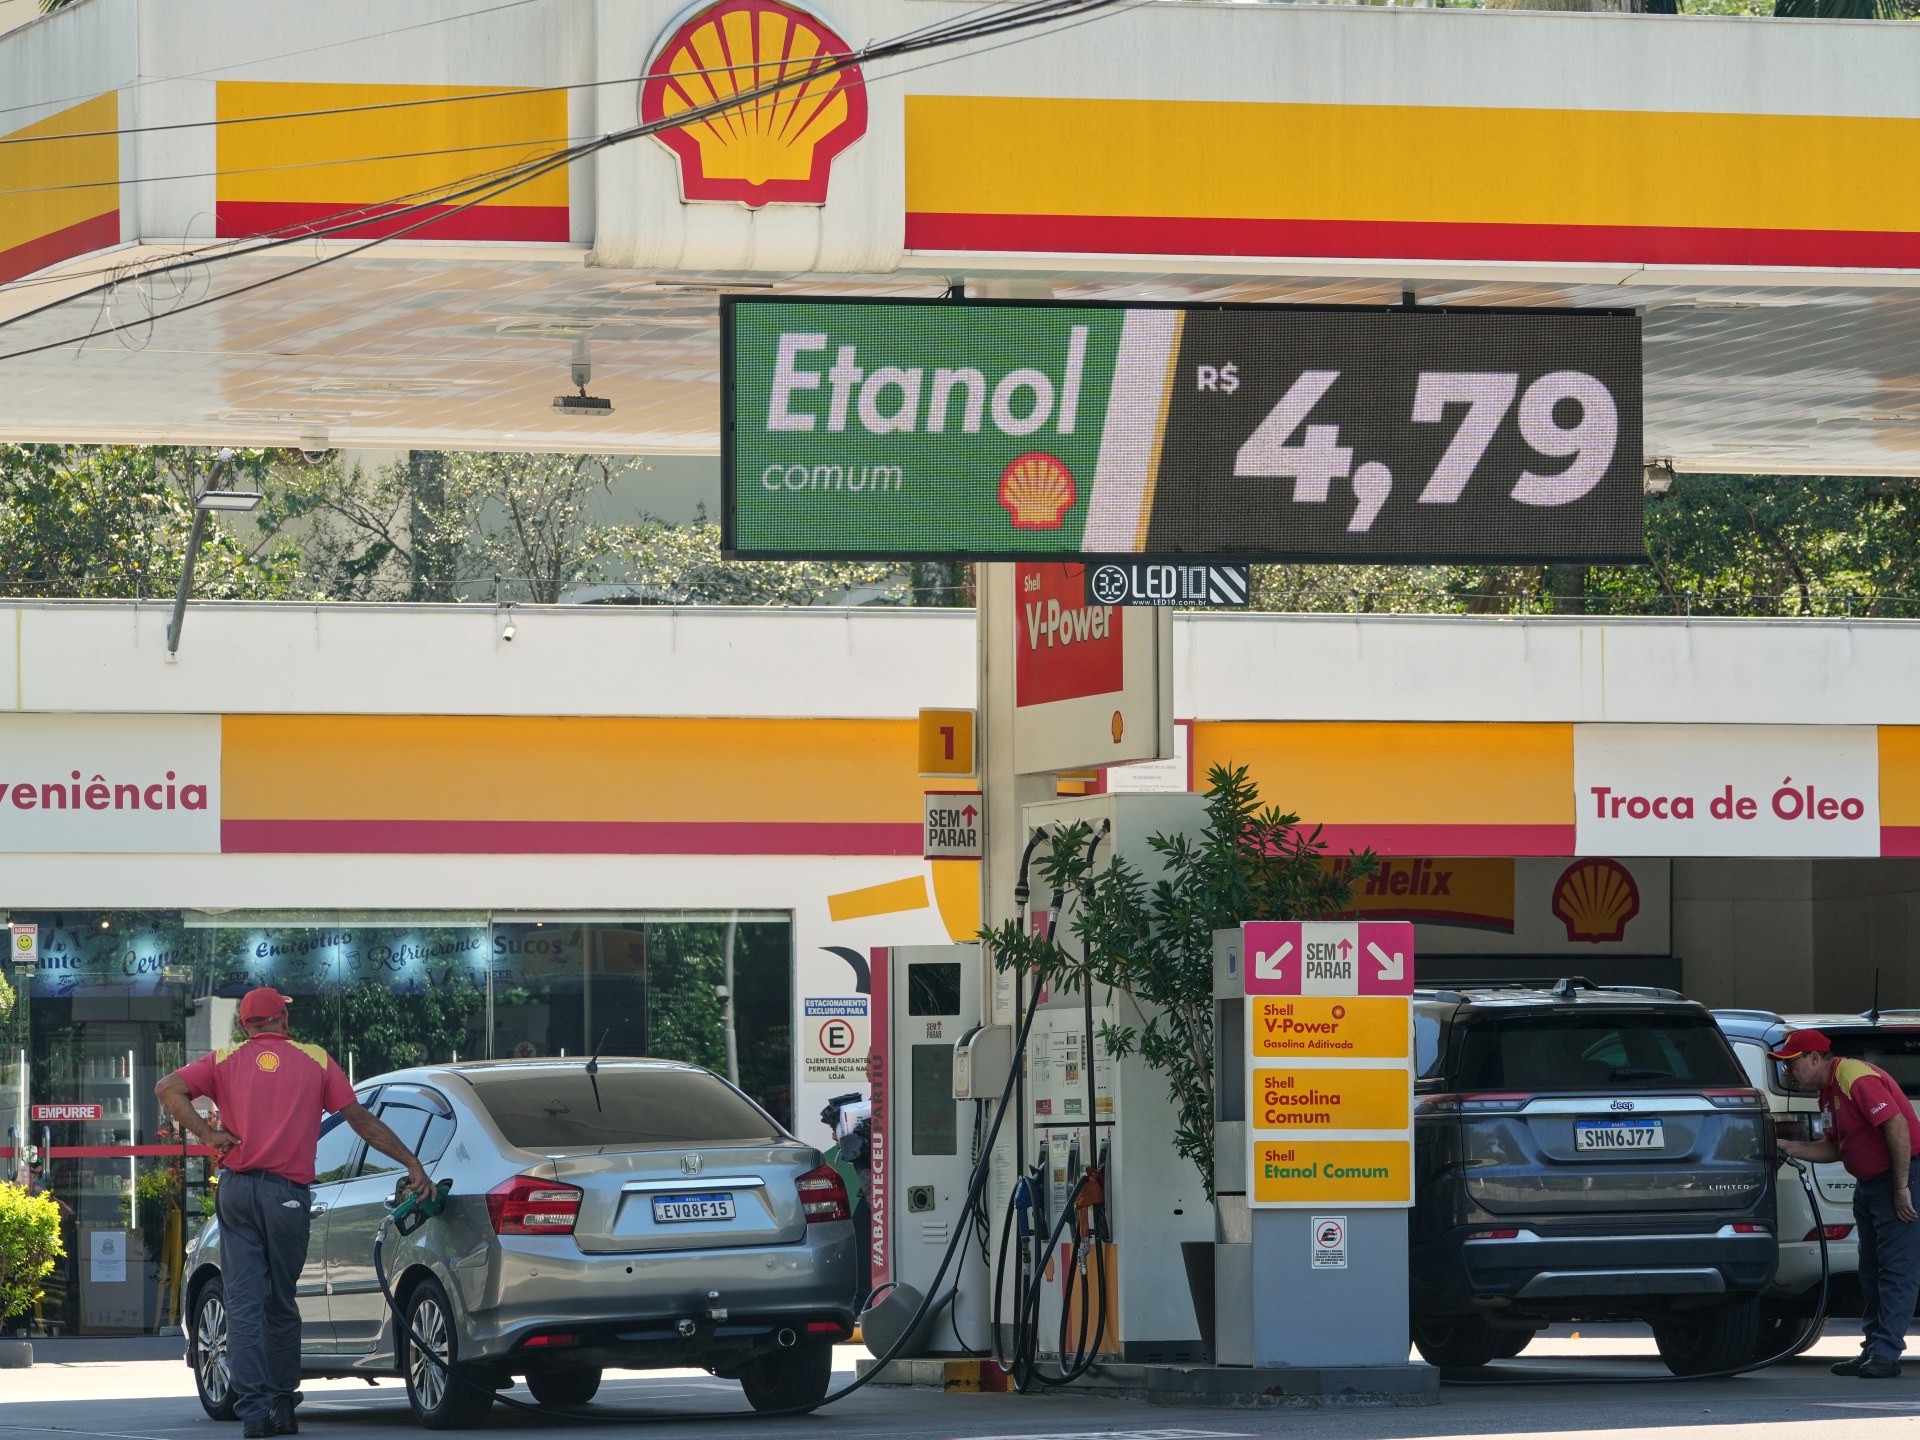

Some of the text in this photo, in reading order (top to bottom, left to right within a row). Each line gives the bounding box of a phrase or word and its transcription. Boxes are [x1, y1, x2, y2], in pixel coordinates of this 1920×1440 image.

[767, 325, 1088, 436] Etanol
[1197, 362, 1618, 532] R$ 4,79
[762, 465, 903, 491] comum
[1024, 573, 1041, 592] Shell
[1132, 566, 1207, 599] LED10
[1025, 598, 1112, 650] V-Power
[940, 727, 954, 760] 1
[1590, 776, 1864, 820] Troca de Óleo
[929, 809, 960, 828] SEM
[929, 829, 977, 847] PARAR
[1365, 859, 1453, 896] Helix
[367, 937, 481, 971] Refrigerante
[494, 935, 563, 955] Sucos
[1306, 943, 1336, 961] SEM
[1306, 961, 1352, 979] PARAR
[808, 1007, 865, 1015] EXCLUSIVO PARA
[1264, 1004, 1294, 1016] Shell
[926, 1023, 936, 1031] SEM
[926, 1031, 942, 1039] PARAR
[1264, 1018, 1338, 1034] V-Power
[829, 1027, 845, 1048] E
[1264, 1039, 1353, 1049] Gasolina Aditivada
[1265, 1077, 1294, 1088] Shell
[1265, 1090, 1341, 1106] Gasolina
[1610, 1100, 1635, 1111] Jeep
[38, 1106, 95, 1119] EMPURRE
[1265, 1109, 1330, 1124] Comum
[1585, 1128, 1655, 1147] SHN6J77
[1265, 1150, 1295, 1161] Shell
[1265, 1163, 1389, 1178] Etanol Comum
[664, 1202, 728, 1218] EVQ8F15
